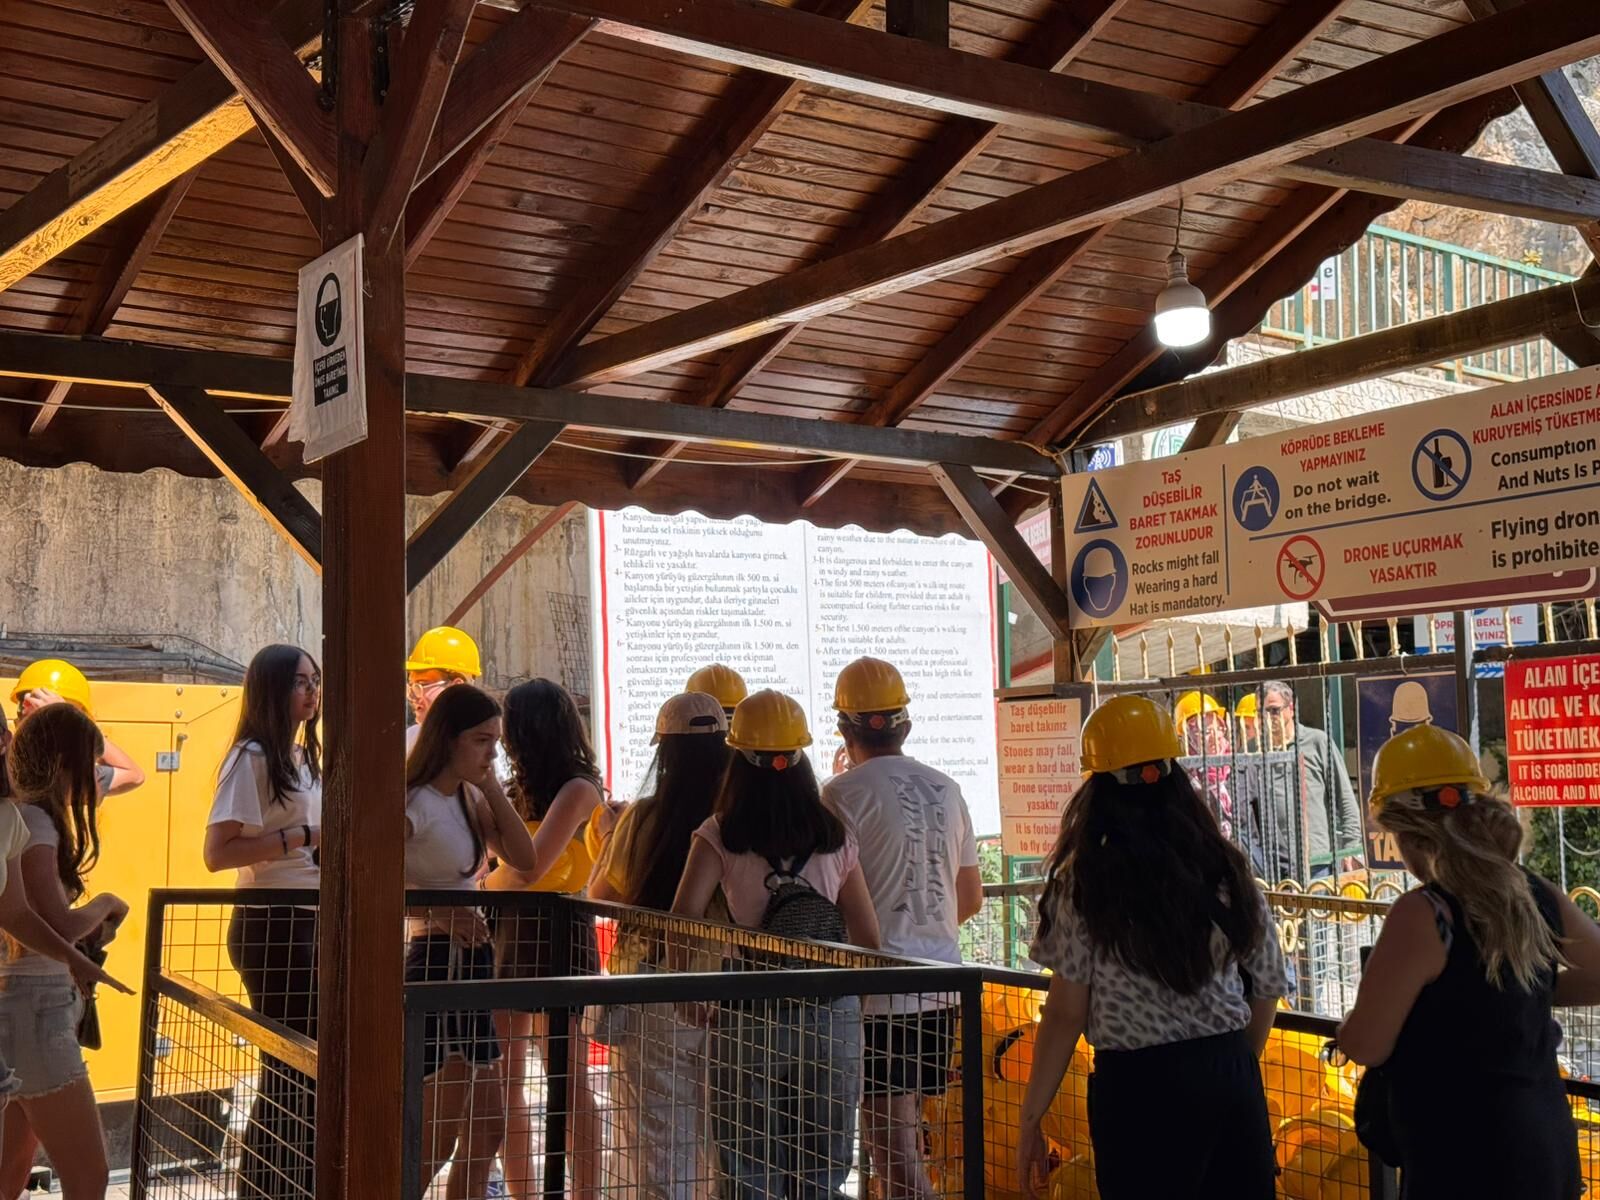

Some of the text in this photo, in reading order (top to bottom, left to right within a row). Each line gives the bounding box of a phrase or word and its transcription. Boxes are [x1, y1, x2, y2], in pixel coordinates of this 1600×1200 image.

[1491, 399, 1523, 418] ALAN
[1526, 386, 1592, 414] İÇERSİNDE
[1280, 422, 1385, 456] KÖPRÜDE BEKLEME
[1473, 417, 1542, 445] KURUYEMİŞ
[1300, 448, 1366, 472] YAPMAYINIZ
[1293, 470, 1380, 498] Do not wait
[1498, 471, 1528, 491] And
[1534, 466, 1570, 485] Nuts
[1574, 463, 1587, 478] Is
[1143, 484, 1202, 508] DÜŞEBİLİR
[1285, 492, 1392, 520] on the bridge.
[1130, 504, 1218, 530] BARET TAKMAK
[1491, 510, 1600, 540] Flying dron
[1135, 526, 1214, 550] ZORUNLUDUR
[1344, 532, 1464, 564] DRONE UÇURMAK
[1132, 550, 1220, 576] Rocks might fall
[1492, 538, 1600, 570] is prohibite
[1135, 572, 1218, 595] Wearing a hard
[1370, 562, 1438, 584] YASAKTIR
[1130, 594, 1225, 616] Hat is mandatory.
[1476, 616, 1524, 627] BEKLME
[1524, 658, 1600, 690] ALAN İÇE
[1010, 702, 1066, 719] Taş düşebilir
[1510, 697, 1560, 721] ALKOL
[1562, 695, 1584, 718] VE
[1010, 720, 1067, 733] baret takınız
[1513, 724, 1600, 752] TÜKETMEK
[1004, 744, 1076, 758] Stones may fall,
[1004, 760, 1076, 774] wear a hard hat
[1518, 765, 1528, 780] IT
[1531, 761, 1542, 780] İS
[1012, 780, 1072, 796] Drone uçurmak
[1513, 784, 1560, 802] ALCOHOL
[1562, 784, 1586, 801] AND
[1026, 799, 1059, 812] yasaktır
[1016, 822, 1022, 834] It
[1024, 822, 1032, 834] is
[1020, 839, 1054, 854] to fly dr
[1368, 831, 1403, 863] TA
